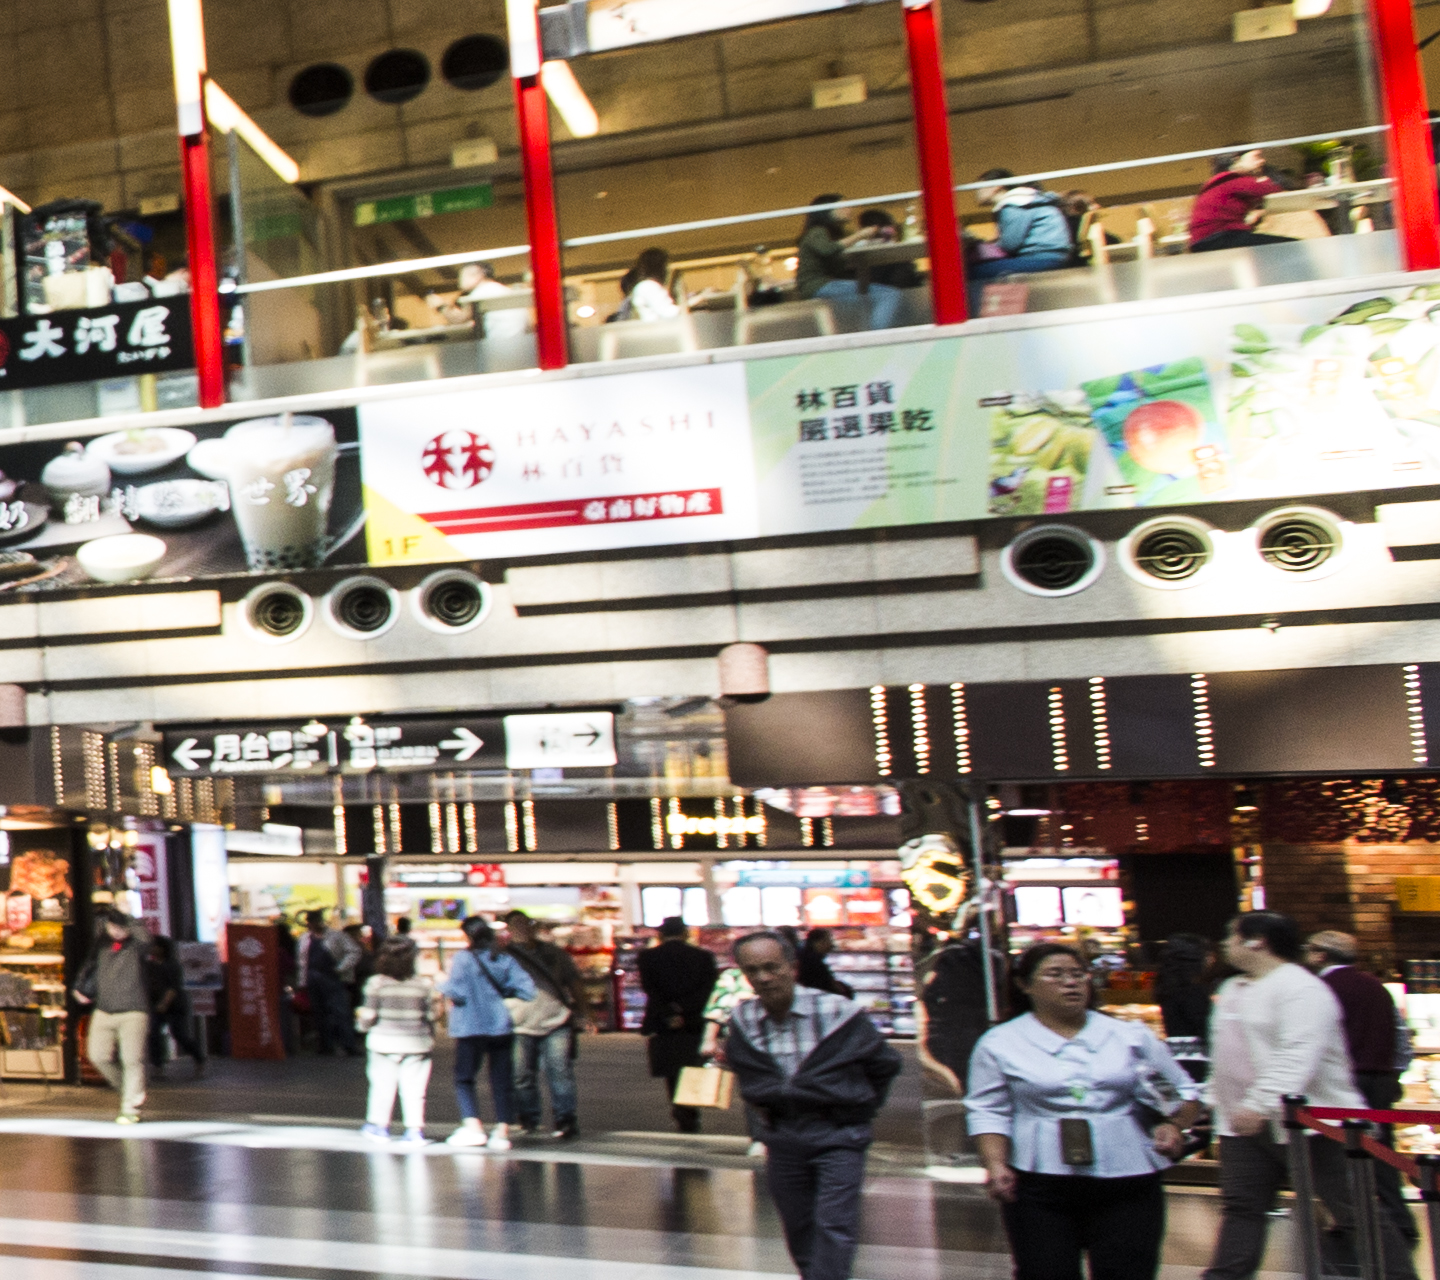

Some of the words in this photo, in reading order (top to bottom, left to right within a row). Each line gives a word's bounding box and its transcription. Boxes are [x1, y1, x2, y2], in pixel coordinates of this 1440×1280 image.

[19, 306, 171, 360] 大河屋
[796, 380, 896, 411] 林百貨
[517, 411, 715, 446] HAYASHI
[214, 732, 270, 762] 月台
